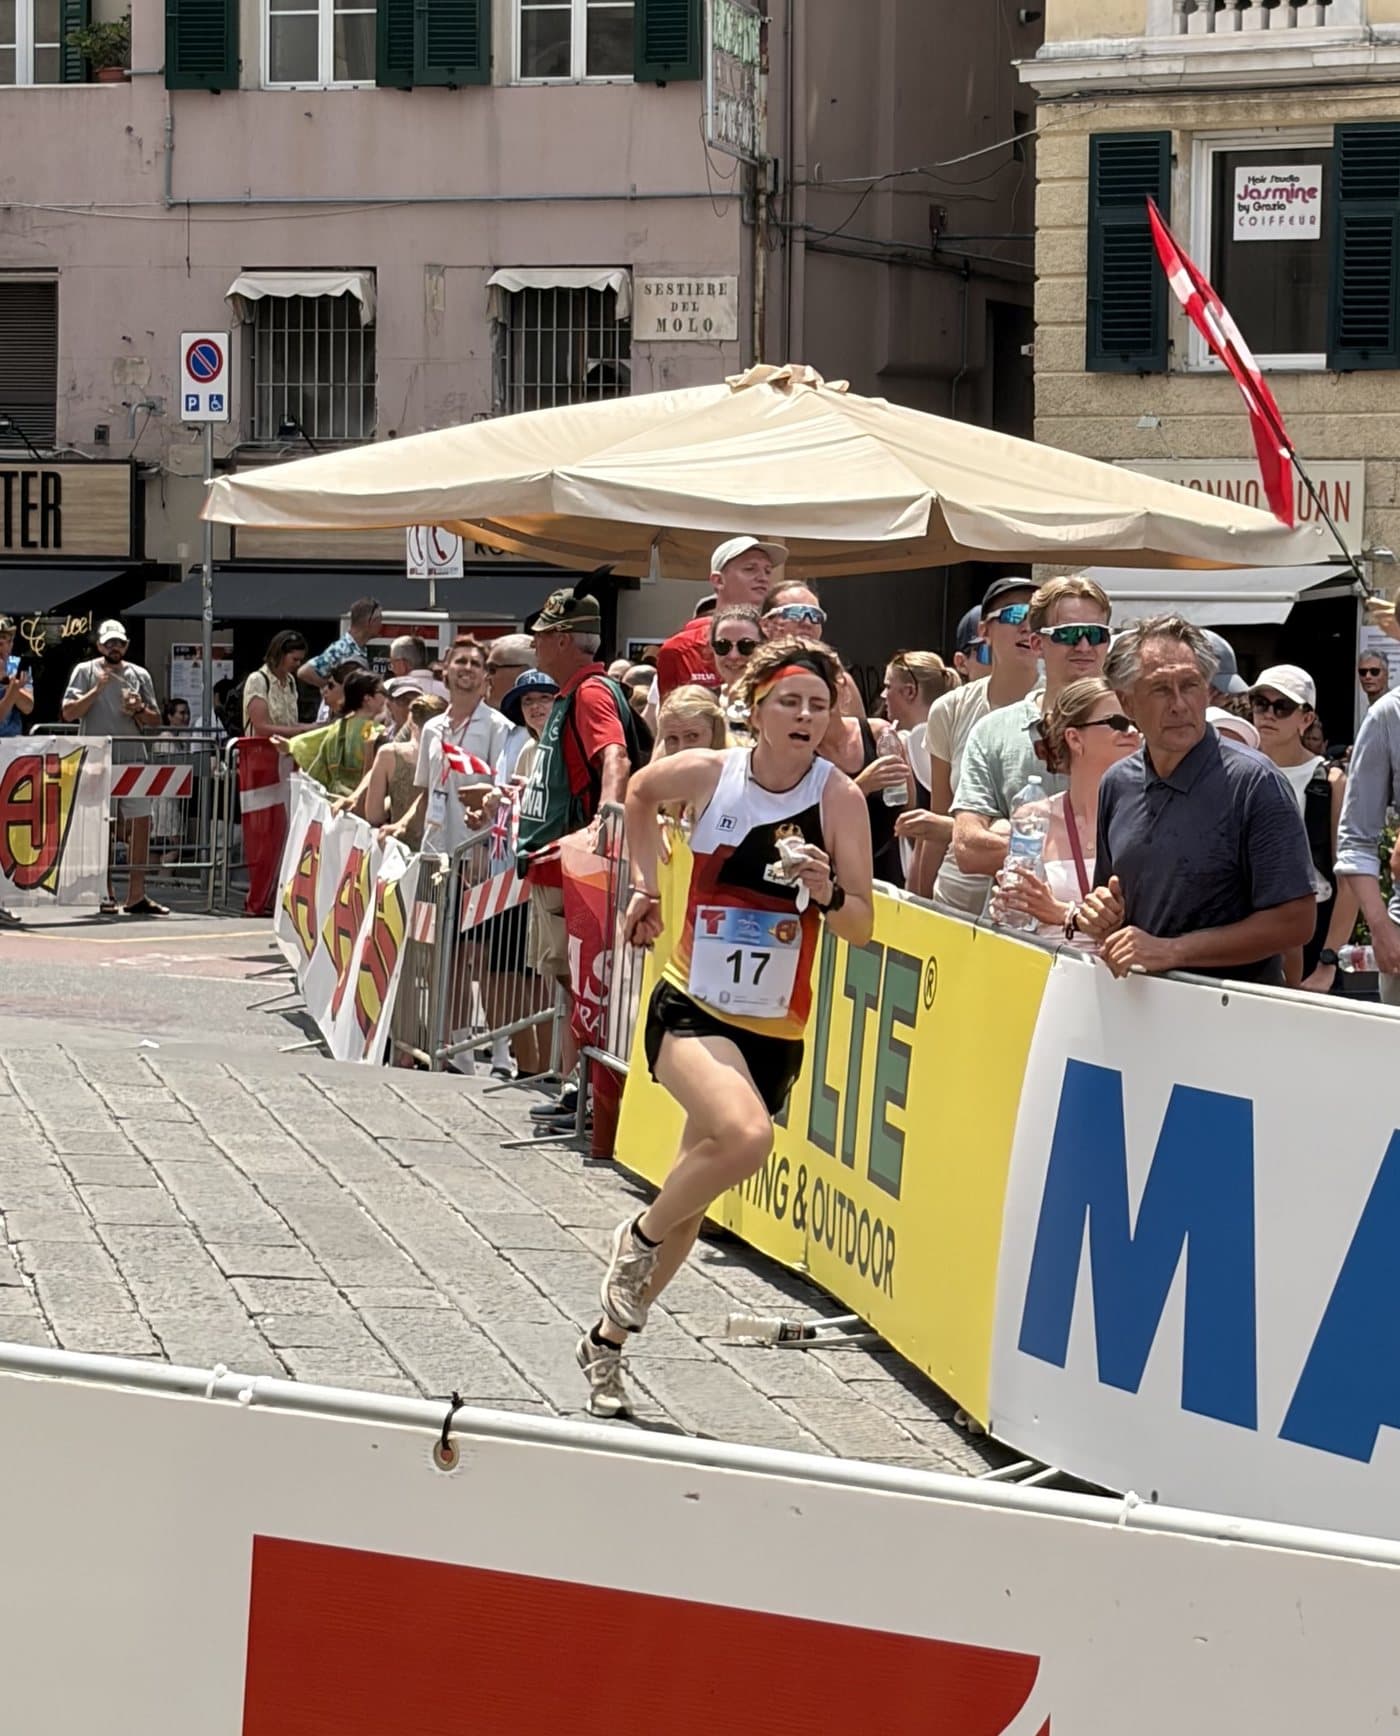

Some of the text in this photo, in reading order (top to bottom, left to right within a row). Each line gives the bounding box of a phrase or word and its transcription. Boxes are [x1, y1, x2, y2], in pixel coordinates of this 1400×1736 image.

[1247, 176, 1267, 185] Hair
[1237, 183, 1318, 203] Jasmine
[1238, 203, 1250, 214] by
[1238, 215, 1317, 227] COIFFEUR
[644, 283, 728, 298] SESTIERE
[671, 302, 700, 312] DEL
[656, 317, 713, 332] MOLO
[188, 396, 198, 410] P
[1298, 479, 1351, 523] UAN
[0, 470, 62, 548] TER
[726, 949, 771, 985] 17
[773, 922, 924, 1201] LTE
[793, 1164, 808, 1232] &
[812, 1175, 896, 1299] OUTDOOR
